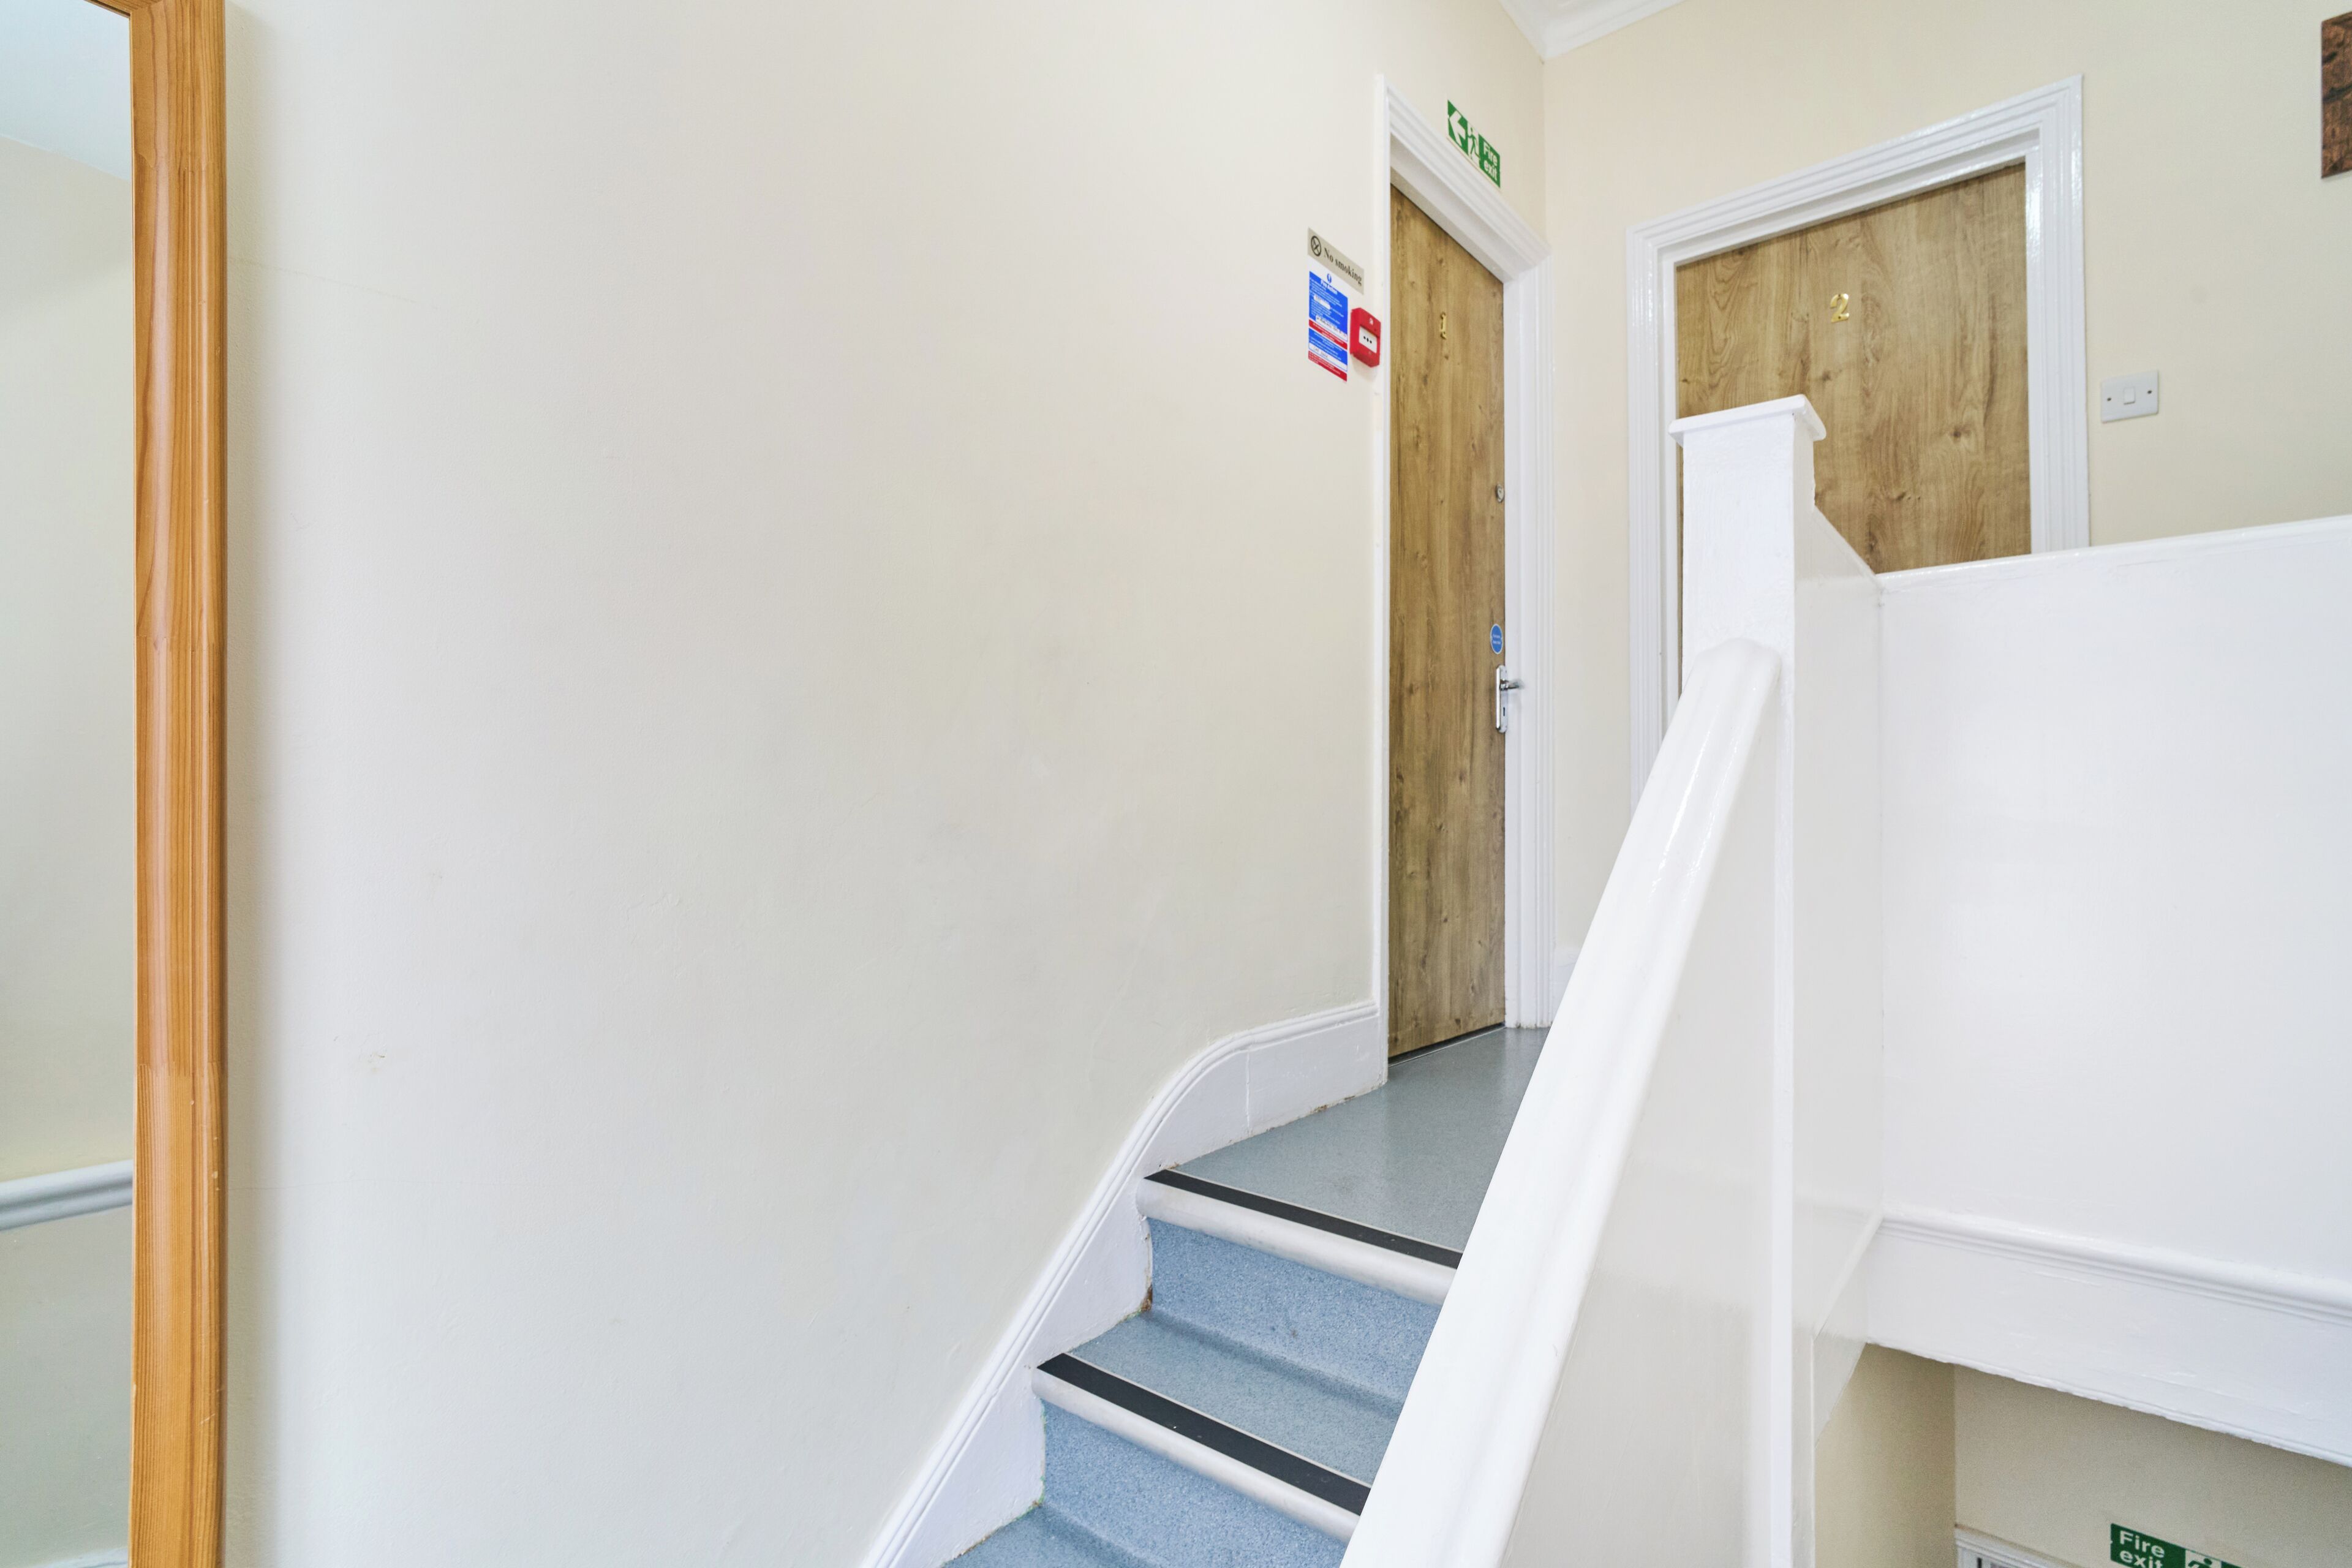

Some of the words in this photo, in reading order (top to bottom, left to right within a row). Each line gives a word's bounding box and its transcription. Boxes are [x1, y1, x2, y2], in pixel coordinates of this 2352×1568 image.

[1483, 141, 1498, 167] Fire
[1484, 160, 1498, 181] exit
[1324, 247, 1333, 263] No
[1335, 258, 1362, 287] smoking
[1830, 293, 1849, 323] 2
[2120, 1530, 2165, 1558] Fire
